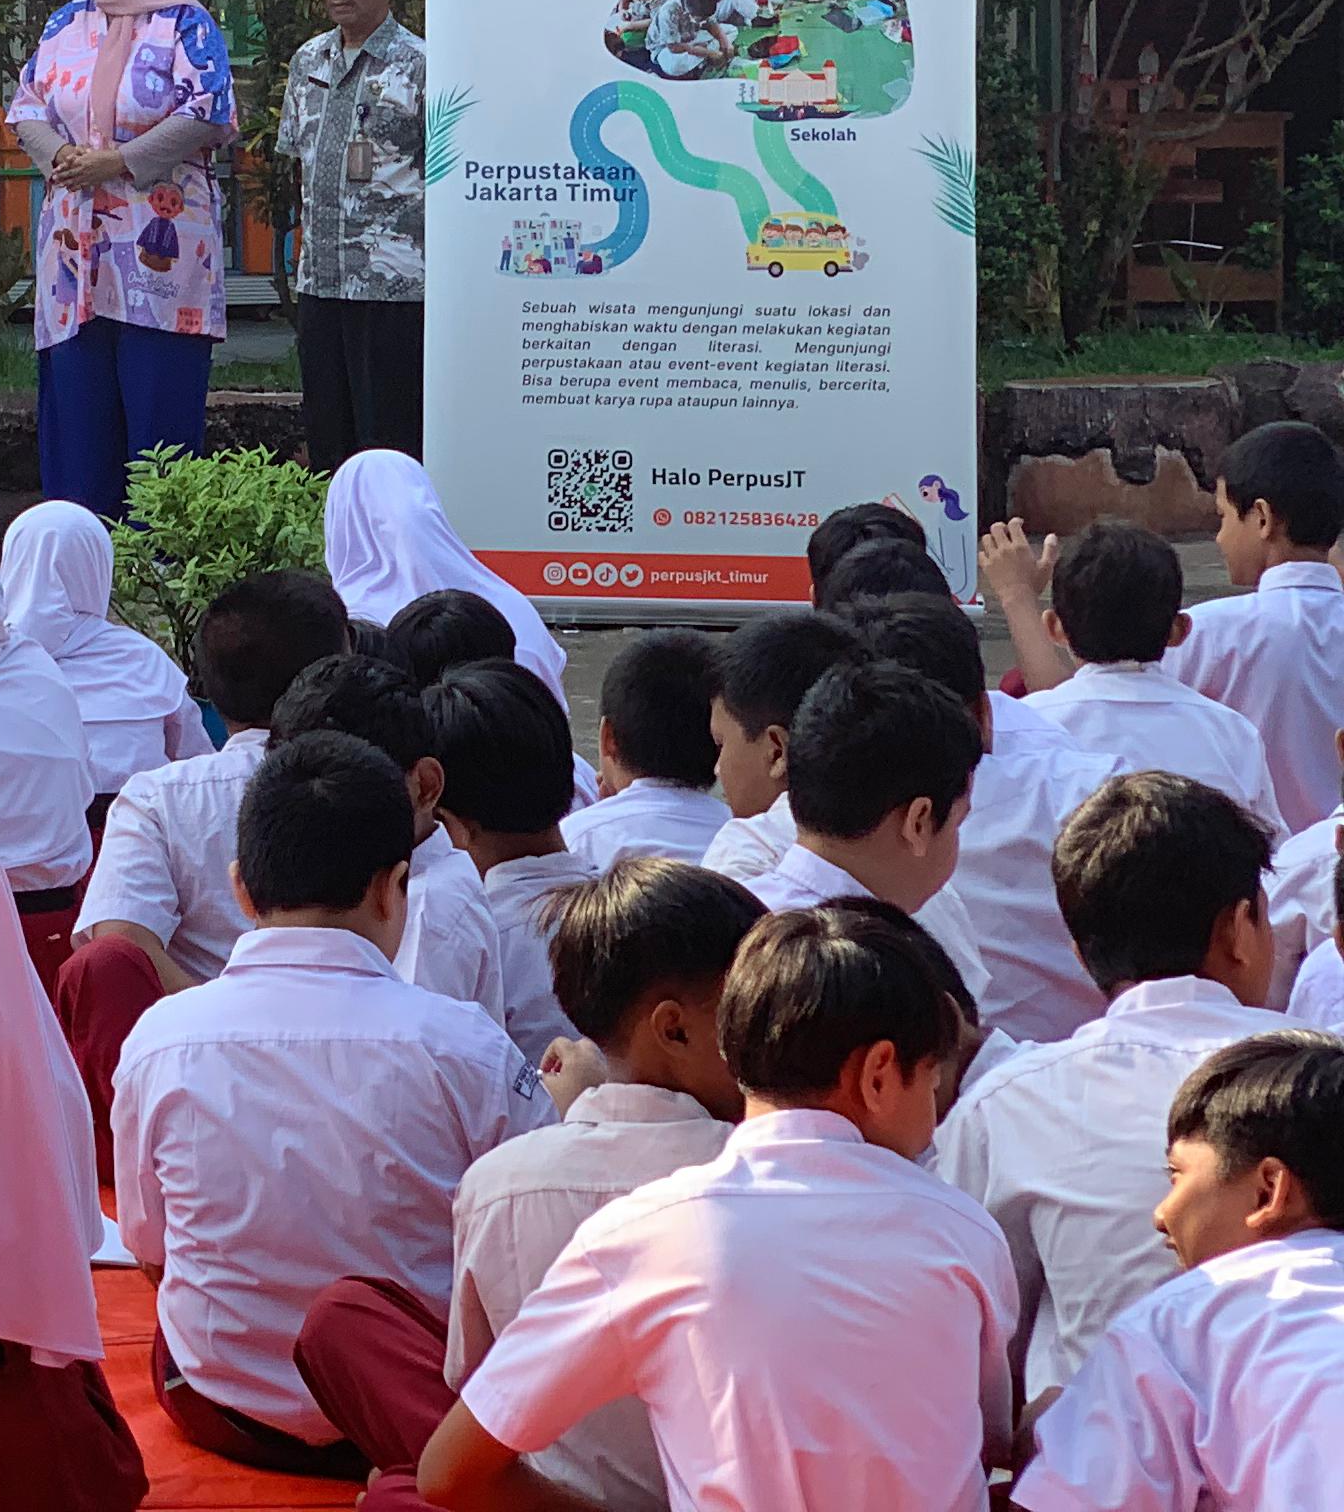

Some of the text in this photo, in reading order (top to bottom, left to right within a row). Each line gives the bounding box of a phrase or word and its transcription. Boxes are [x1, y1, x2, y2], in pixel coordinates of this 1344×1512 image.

[790, 128, 857, 141] Sekolah
[465, 161, 636, 184] Perpustakaan
[465, 183, 638, 202] Jakarta Timur
[522, 301, 891, 318] Sebuah wisata mengunjungi suatu lokasi dan
[522, 320, 890, 338] menghabiskan waktu dengan melakukan kegiatan
[522, 338, 892, 356] berkaitan dengan literasi. Mengunjungi
[521, 357, 890, 374] perpustakaan atau event-event kegiatan literasi.
[522, 375, 890, 393] Bisa berupa event membaca, menulis, bercerita,
[522, 394, 799, 411] membuat karya rupa ataupun lainnya.
[652, 468, 806, 491] Halo PerpusJT
[684, 510, 819, 527] 082125836428
[650, 569, 768, 585] perpusjkt_timur
